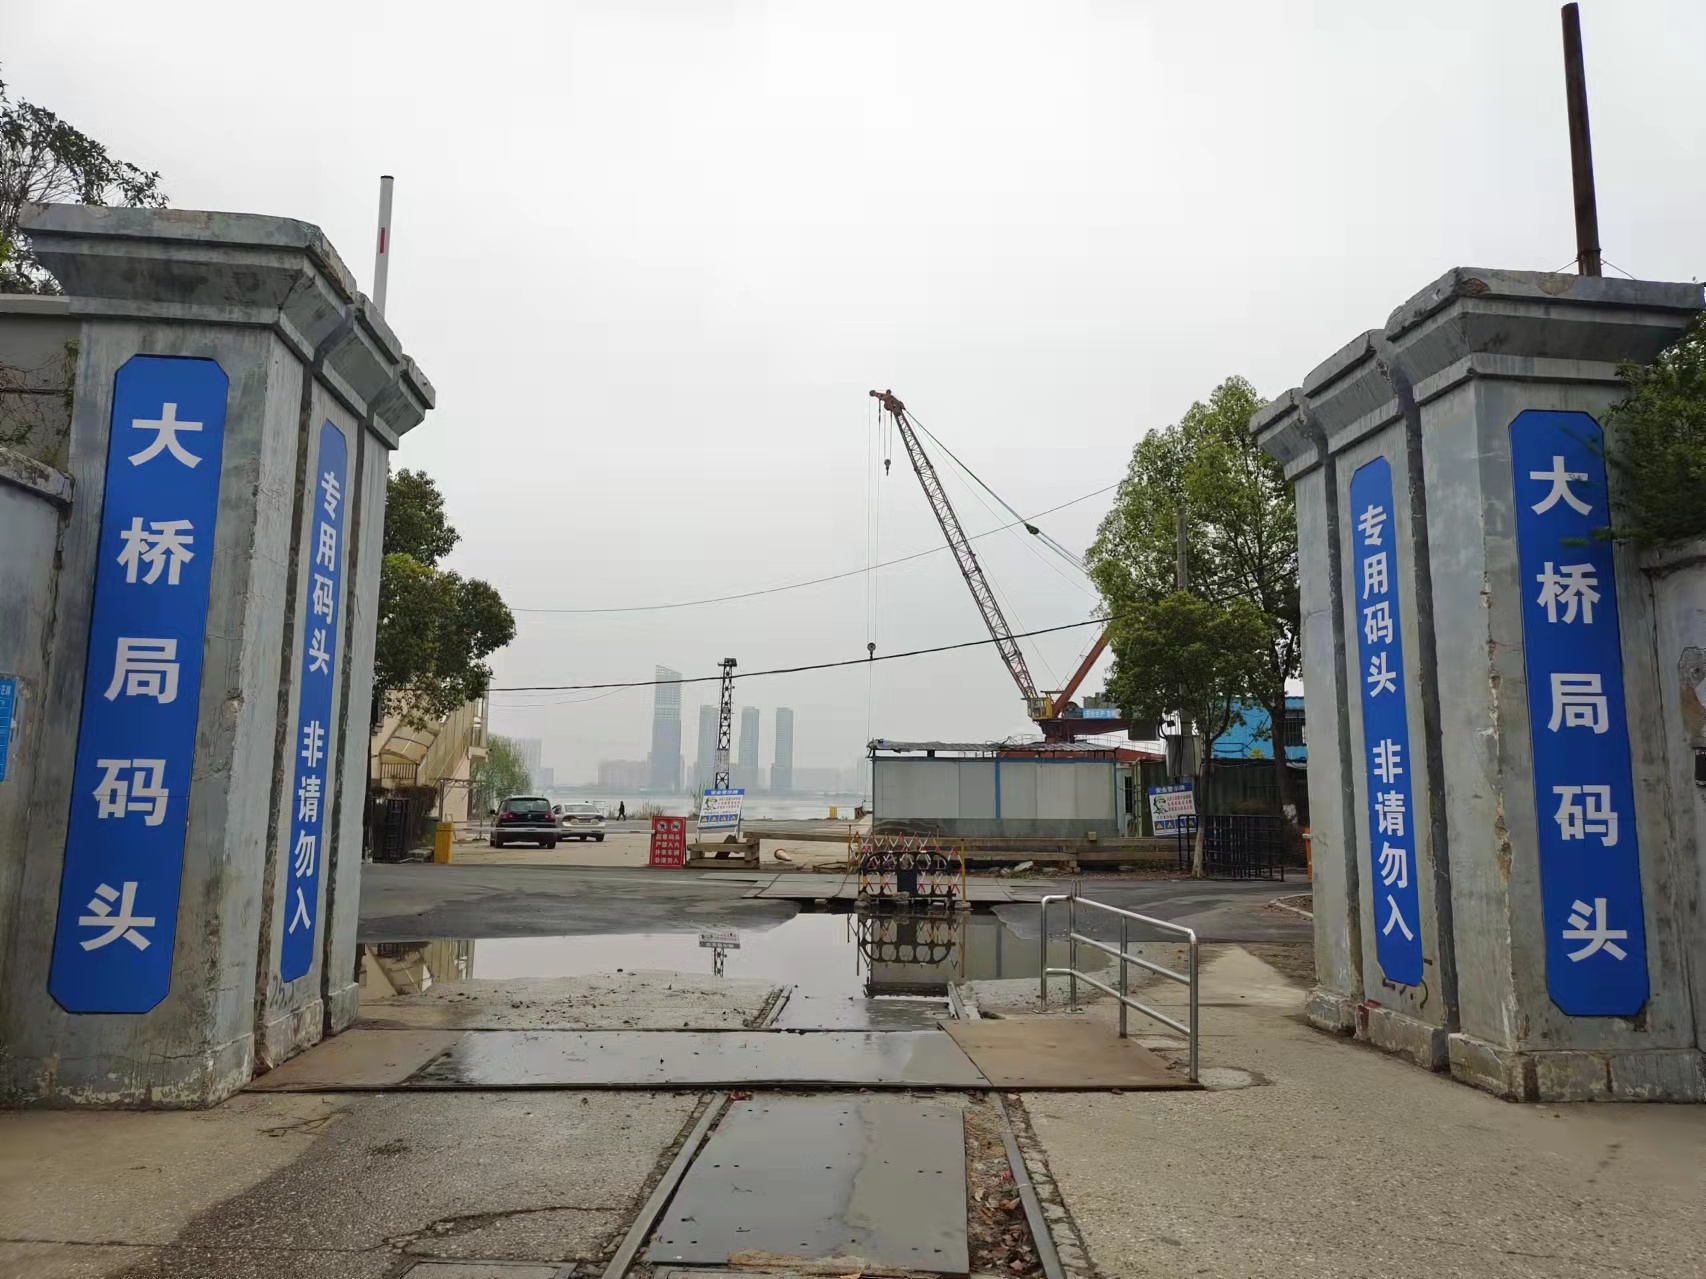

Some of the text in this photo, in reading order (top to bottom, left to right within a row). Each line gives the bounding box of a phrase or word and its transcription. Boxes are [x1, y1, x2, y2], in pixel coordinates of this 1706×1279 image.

[80, 402, 203, 951] 大桥局码头
[288, 471, 341, 935] 专用码头 非请勿入
[1357, 504, 1397, 698] 专用码头
[1529, 455, 1627, 962] 大桥局码头
[1372, 738, 1414, 942] 非请勿入
